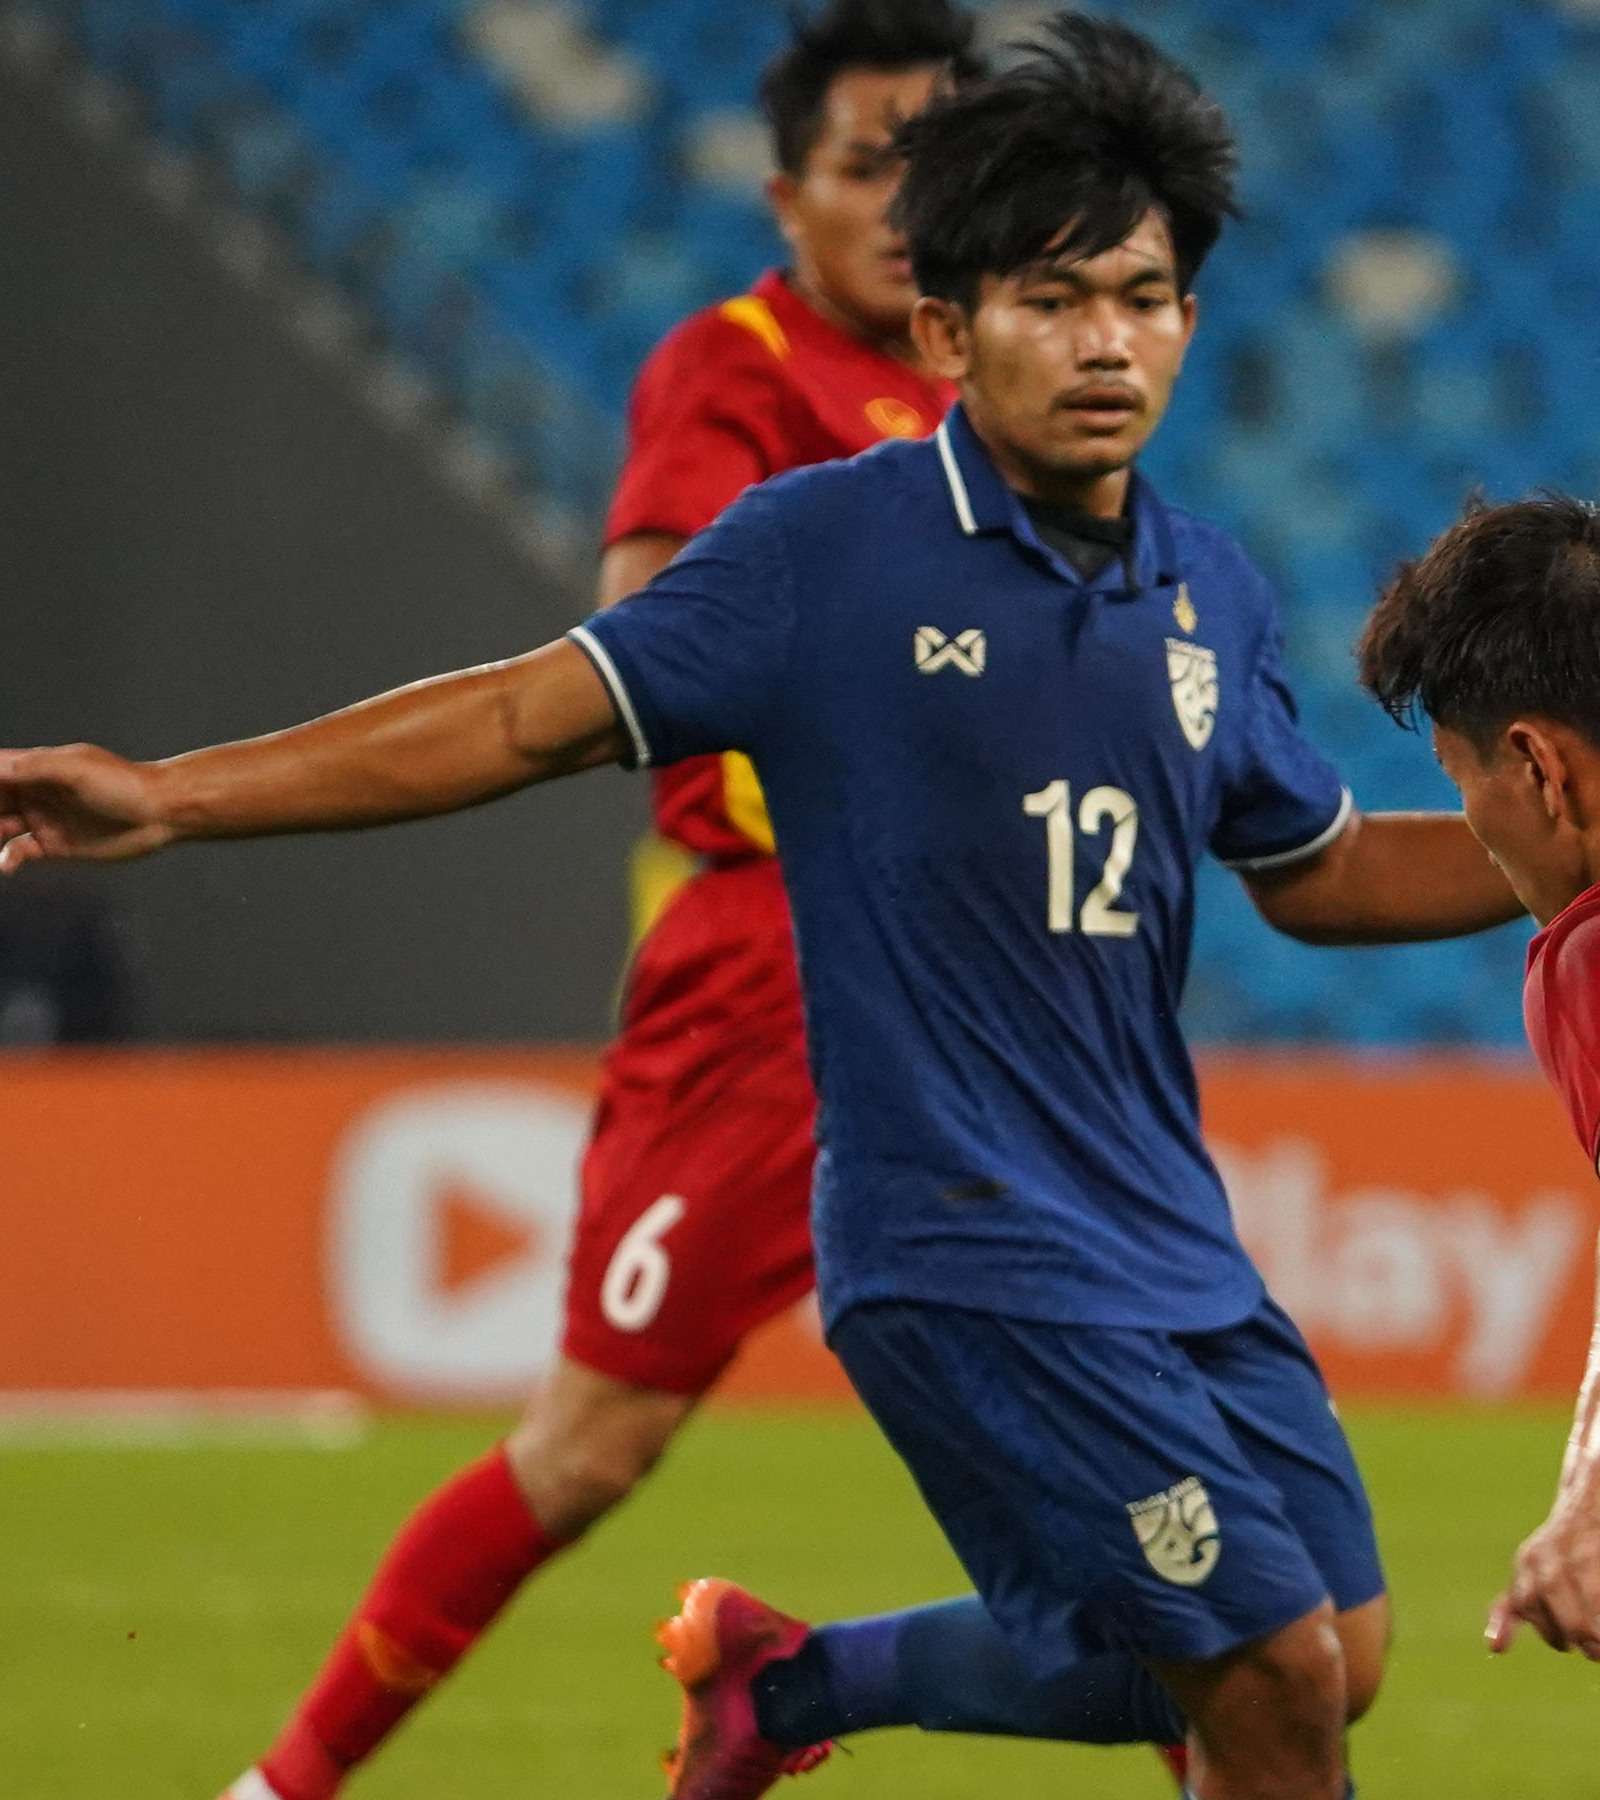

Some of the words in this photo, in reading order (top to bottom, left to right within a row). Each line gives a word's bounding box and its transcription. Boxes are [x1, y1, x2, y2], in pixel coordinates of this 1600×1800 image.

[1023, 779, 1141, 937] 12
[601, 1195, 685, 1331] 6
[1206, 1138, 1580, 1392] lay
